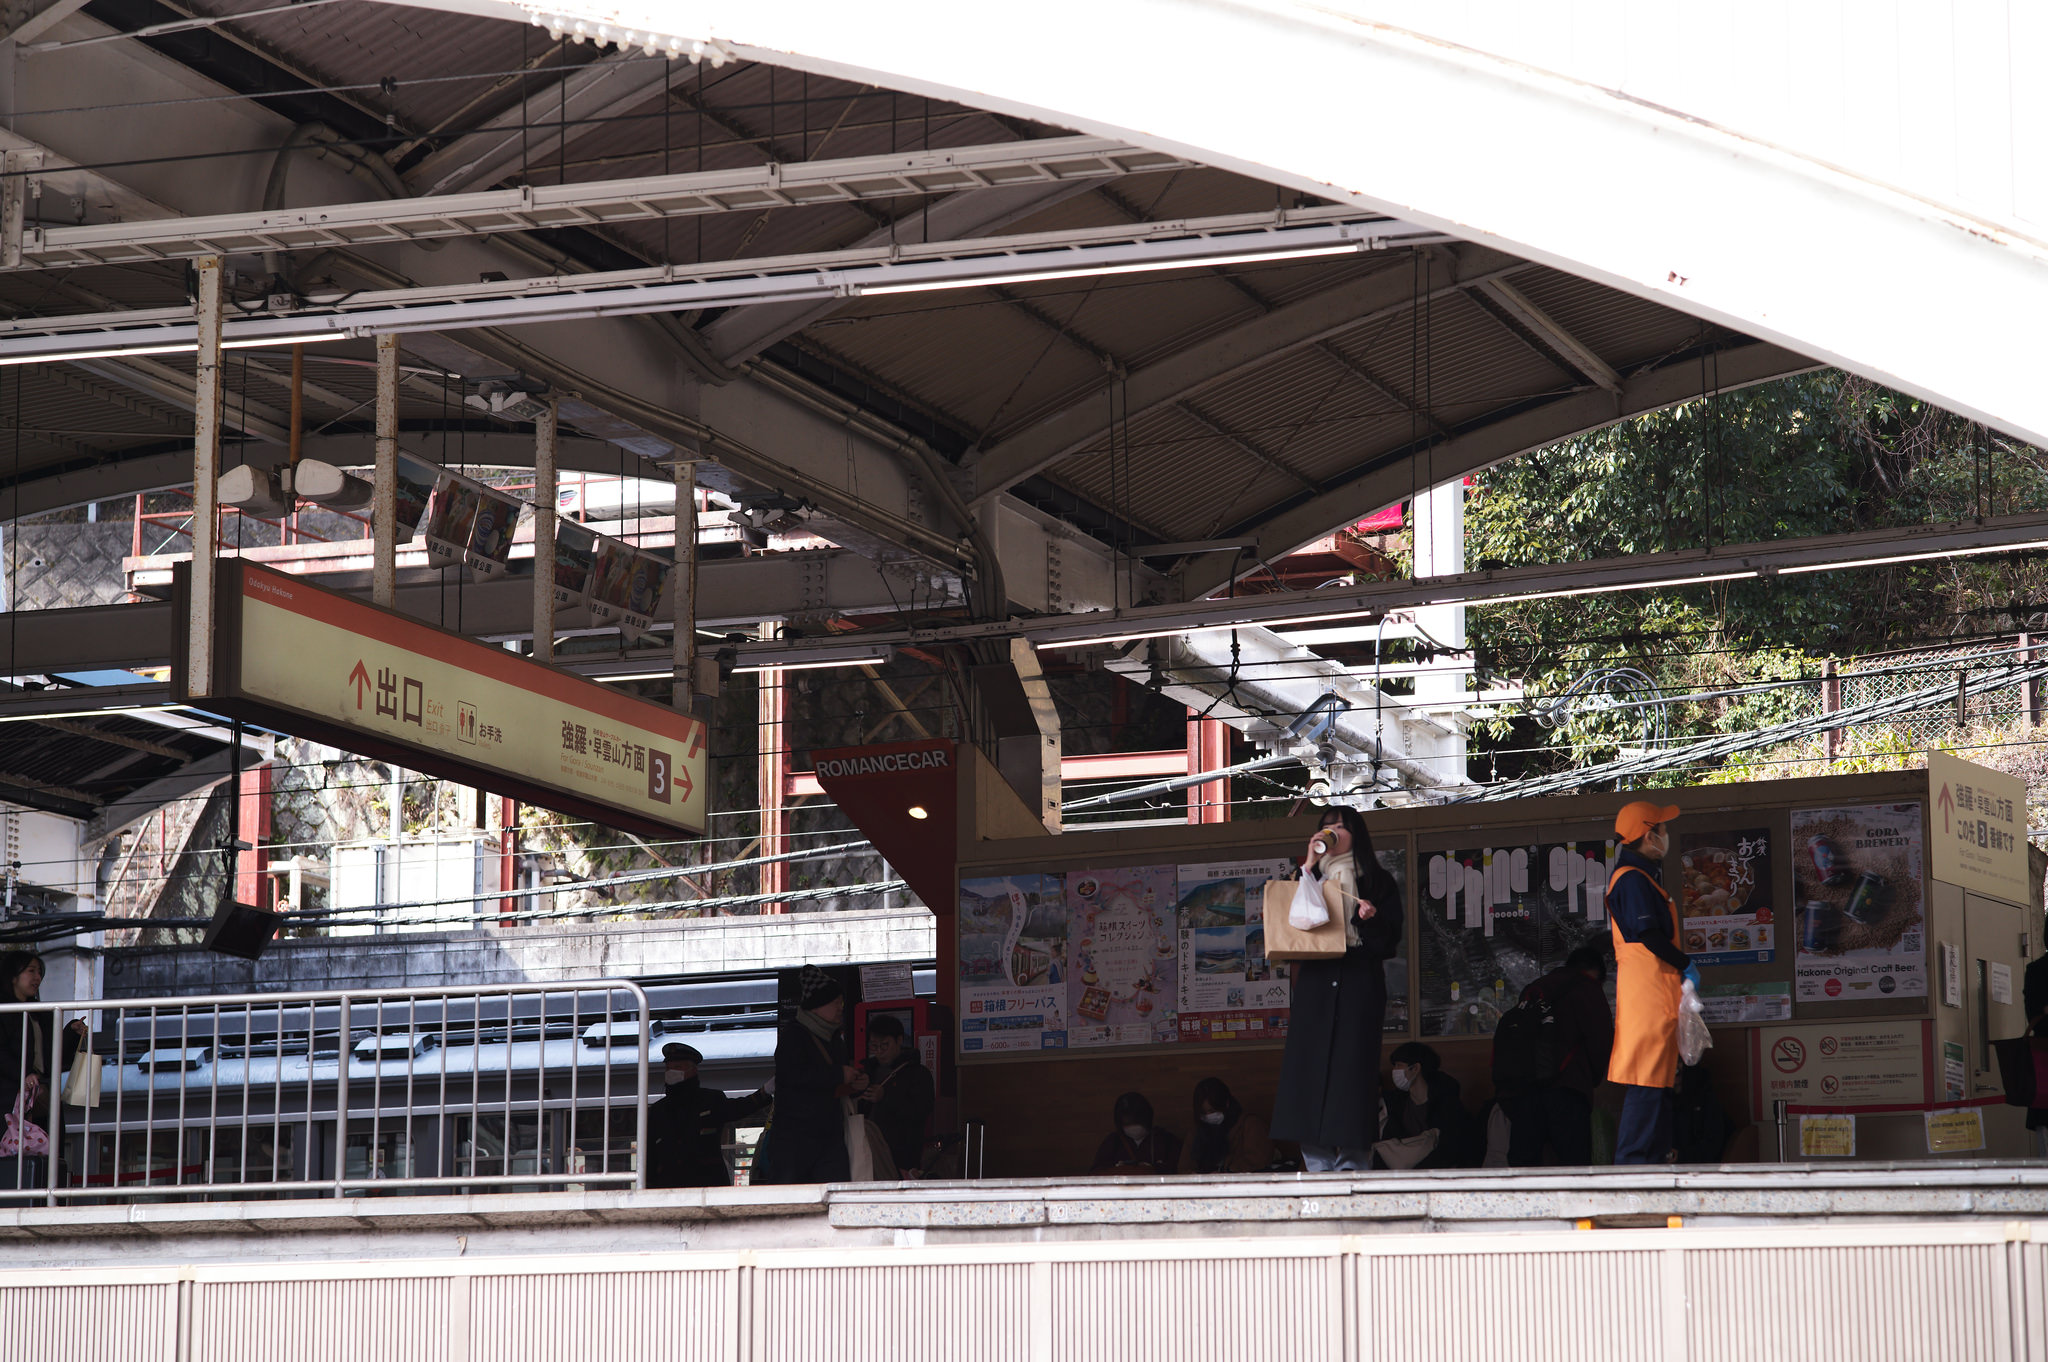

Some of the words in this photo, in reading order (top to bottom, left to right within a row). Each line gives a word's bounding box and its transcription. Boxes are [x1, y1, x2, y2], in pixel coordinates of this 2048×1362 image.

[249, 577, 270, 592] Odakyu
[272, 585, 293, 600] Hakone
[376, 667, 423, 727] 出口
[426, 699, 444, 718] Exit
[479, 723, 503, 743] お手洗
[561, 720, 646, 773] 強羅・早雲山方面
[653, 758, 665, 795] 3
[816, 750, 948, 778] ROMANCECAR
[1956, 783, 2013, 824] 強羅・早雲山方面
[1866, 827, 1900, 837] GORA
[1957, 820, 1976, 844] この先
[1990, 827, 2015, 853] 番線です
[1855, 837, 1911, 848] BREWERY
[1737, 837, 1755, 885] おでん
[1728, 856, 1741, 897] まつり
[1099, 920, 1145, 932] 箱根スイーツ
[1099, 932, 1145, 942] コレクション
[1797, 968, 1832, 977] Hakone
[1834, 965, 1869, 976] Original
[1871, 964, 1893, 973] Craft
[1895, 964, 1918, 972] Beer.
[984, 996, 1057, 1013] 箱根フリーパス
[1181, 1019, 1201, 1031] 箱根
[1770, 1079, 1809, 1089] 駅構内禁煙
[1302, 1200, 1319, 1214] 20
